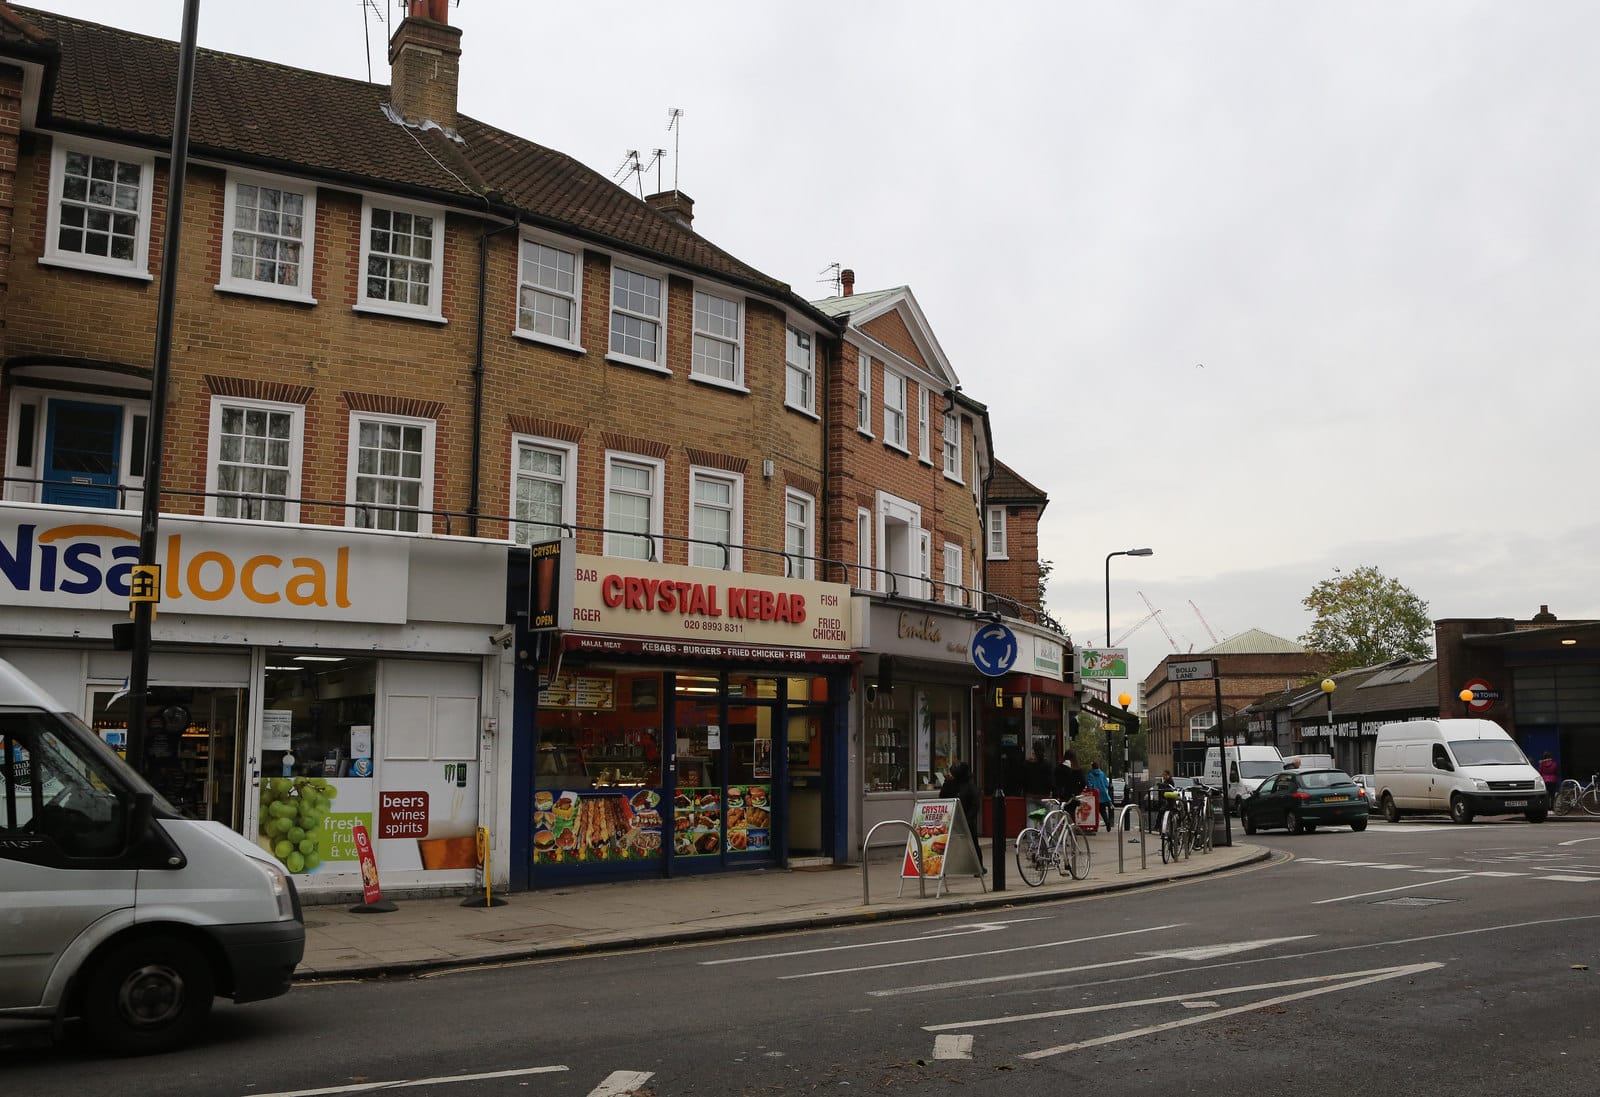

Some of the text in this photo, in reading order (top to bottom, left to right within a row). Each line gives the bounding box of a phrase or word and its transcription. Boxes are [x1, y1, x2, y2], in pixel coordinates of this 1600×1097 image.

[532, 543, 560, 557] CRYSTAL
[0, 524, 352, 608] Nisa local
[576, 568, 598, 583] BAB
[602, 574, 807, 624] CRYSTAL KEBAB
[820, 595, 838, 607] FISH
[535, 614, 553, 626] OPEN
[573, 607, 601, 622] RGER
[684, 619, 743, 633] 020 8993 8311
[818, 617, 841, 629] FRIED
[812, 628, 846, 641] CHICKEN
[581, 640, 622, 649] HALAL MEAT
[642, 642, 677, 653] KEBABS
[683, 645, 721, 656] BURGERS
[727, 647, 750, 657] FRIED
[751, 649, 784, 659] CHICKEN
[789, 651, 806, 659] FISH
[1090, 669, 1114, 677] OPEN
[1175, 666, 1198, 674] BOLLO
[383, 794, 424, 808] beers
[391, 809, 426, 820] wines
[921, 804, 949, 815] CRYSTAL
[324, 816, 363, 830] fresh
[924, 813, 943, 821] KEBAB
[385, 821, 423, 836] spirits
[345, 848, 359, 857] ve
